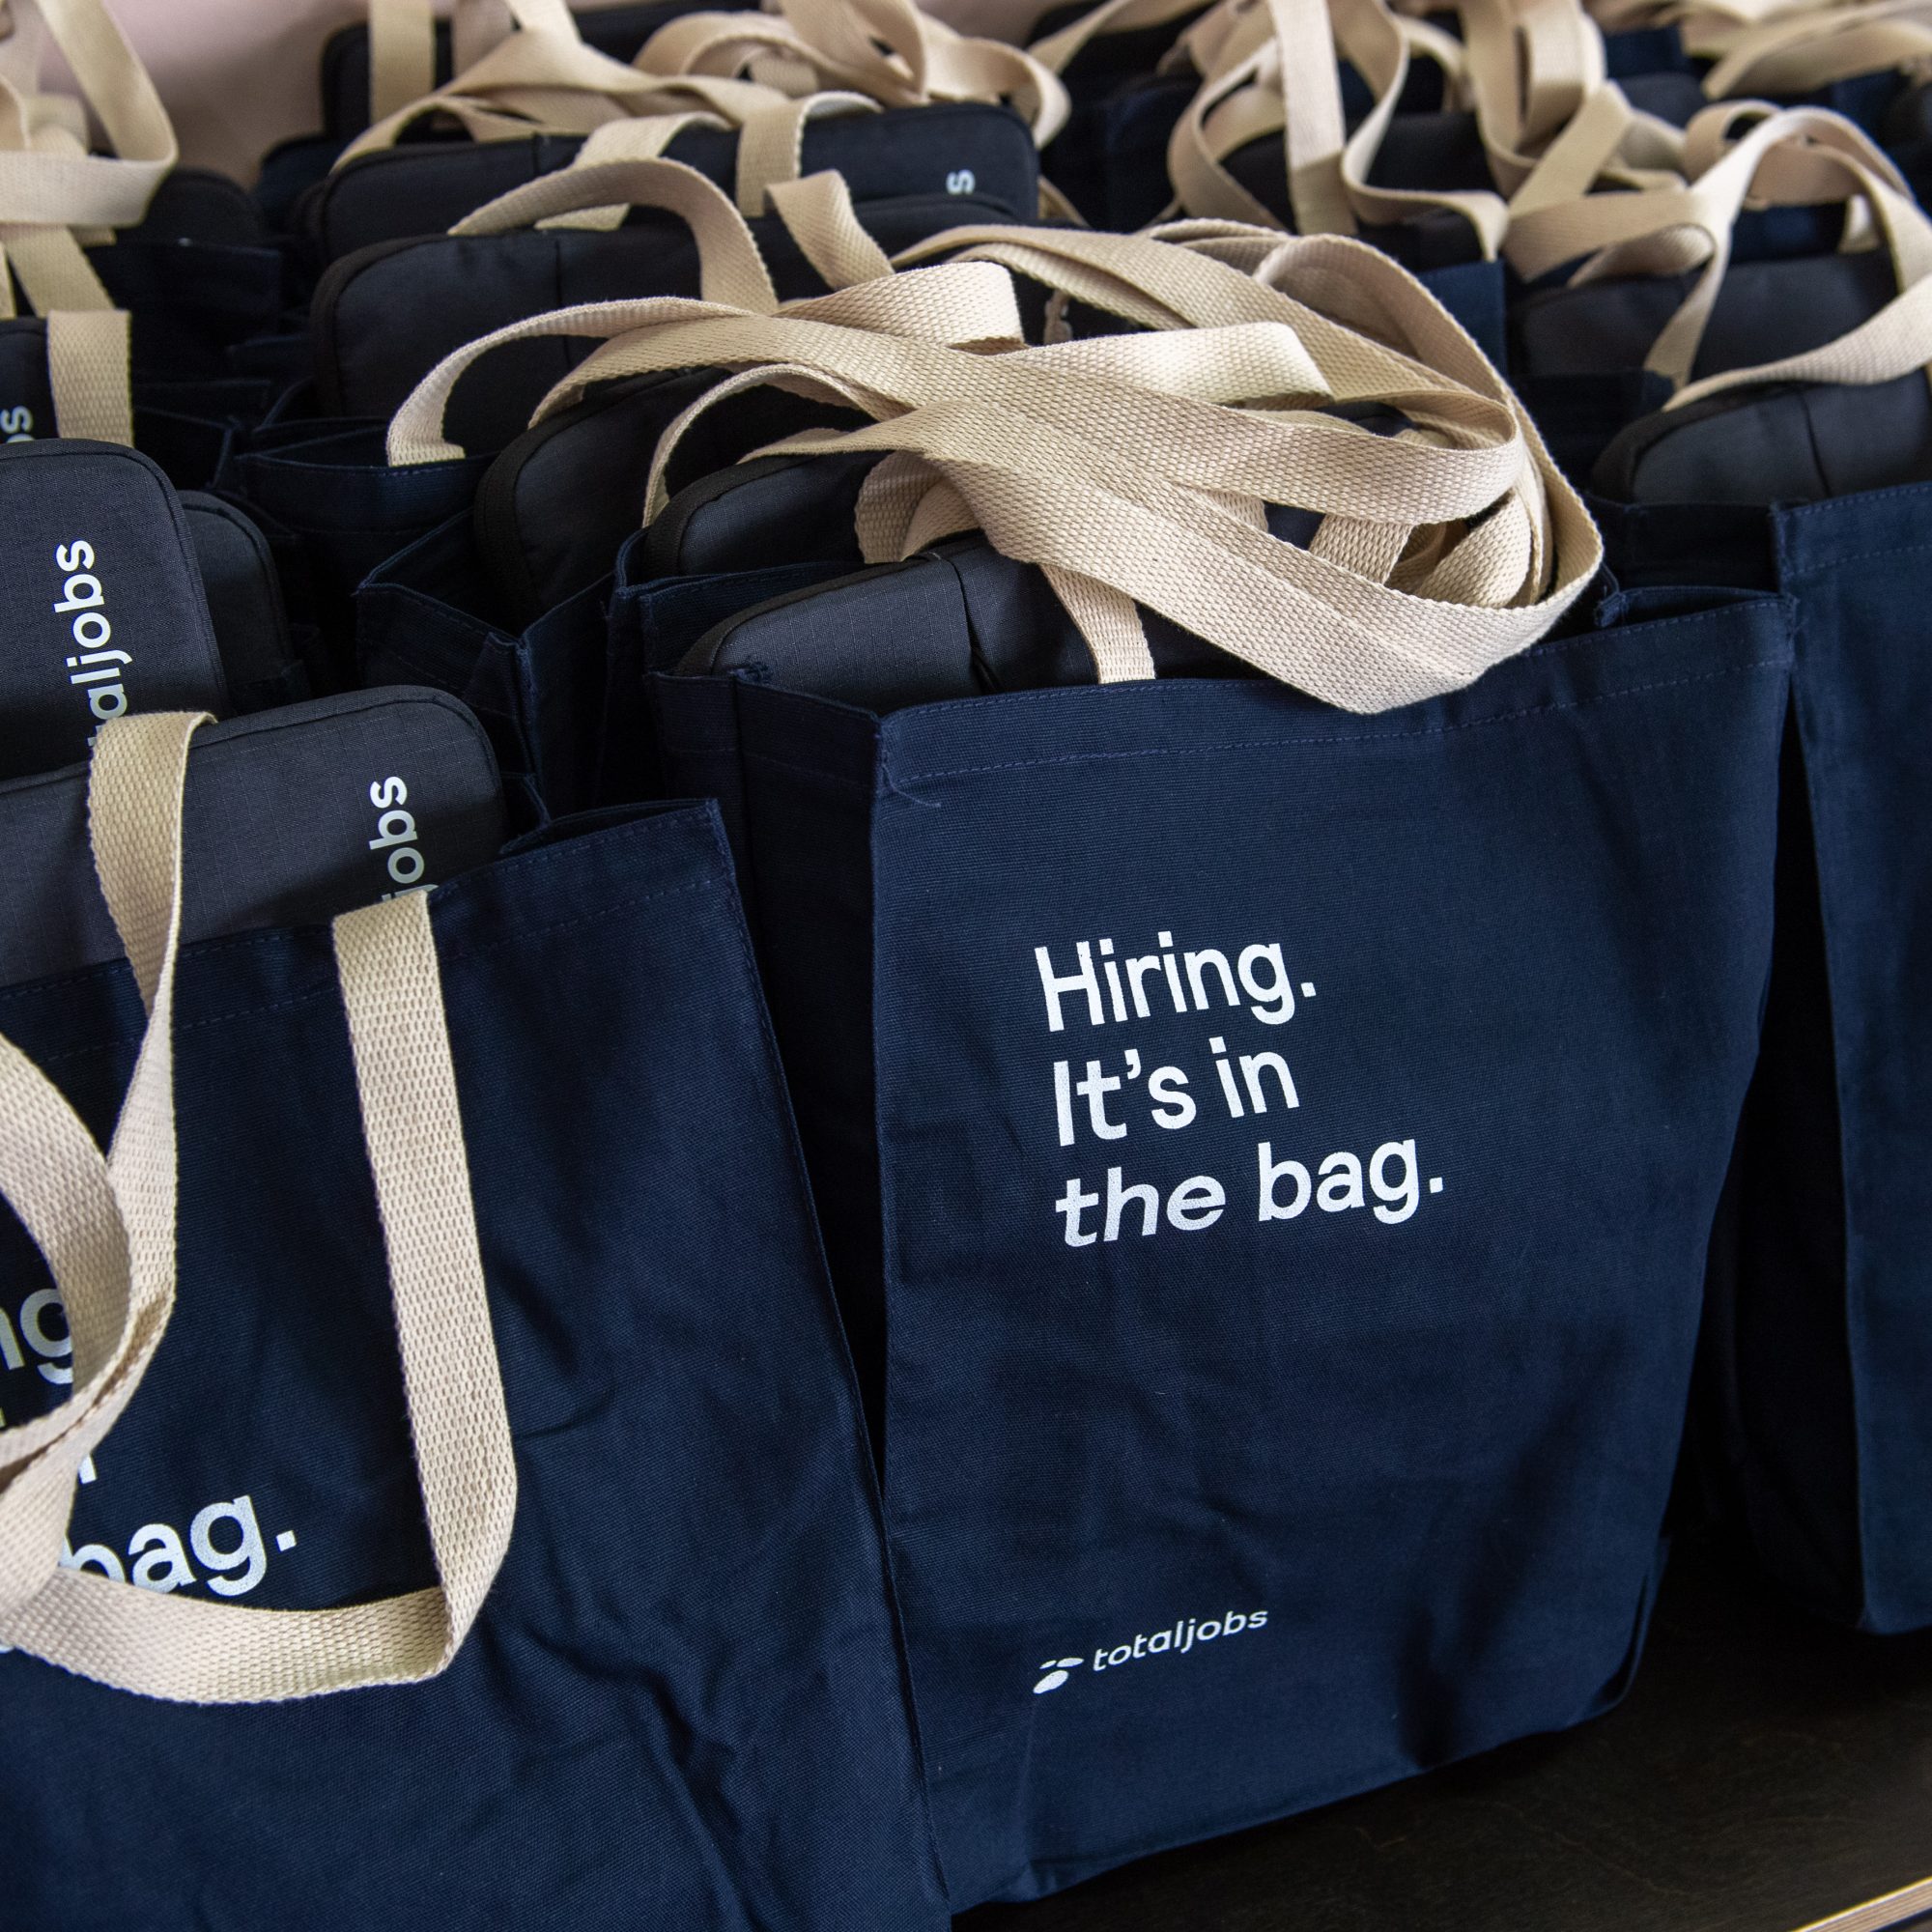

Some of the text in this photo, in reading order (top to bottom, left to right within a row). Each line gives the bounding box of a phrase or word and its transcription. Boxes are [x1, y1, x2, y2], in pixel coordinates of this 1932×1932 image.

[54, 540, 132, 747] aljobs
[1034, 930, 1317, 1033] Hiring.
[1053, 1036, 1300, 1147] It’s in
[1055, 1138, 1444, 1247] the bag.
[1093, 1610, 1268, 1672] totaljobs
